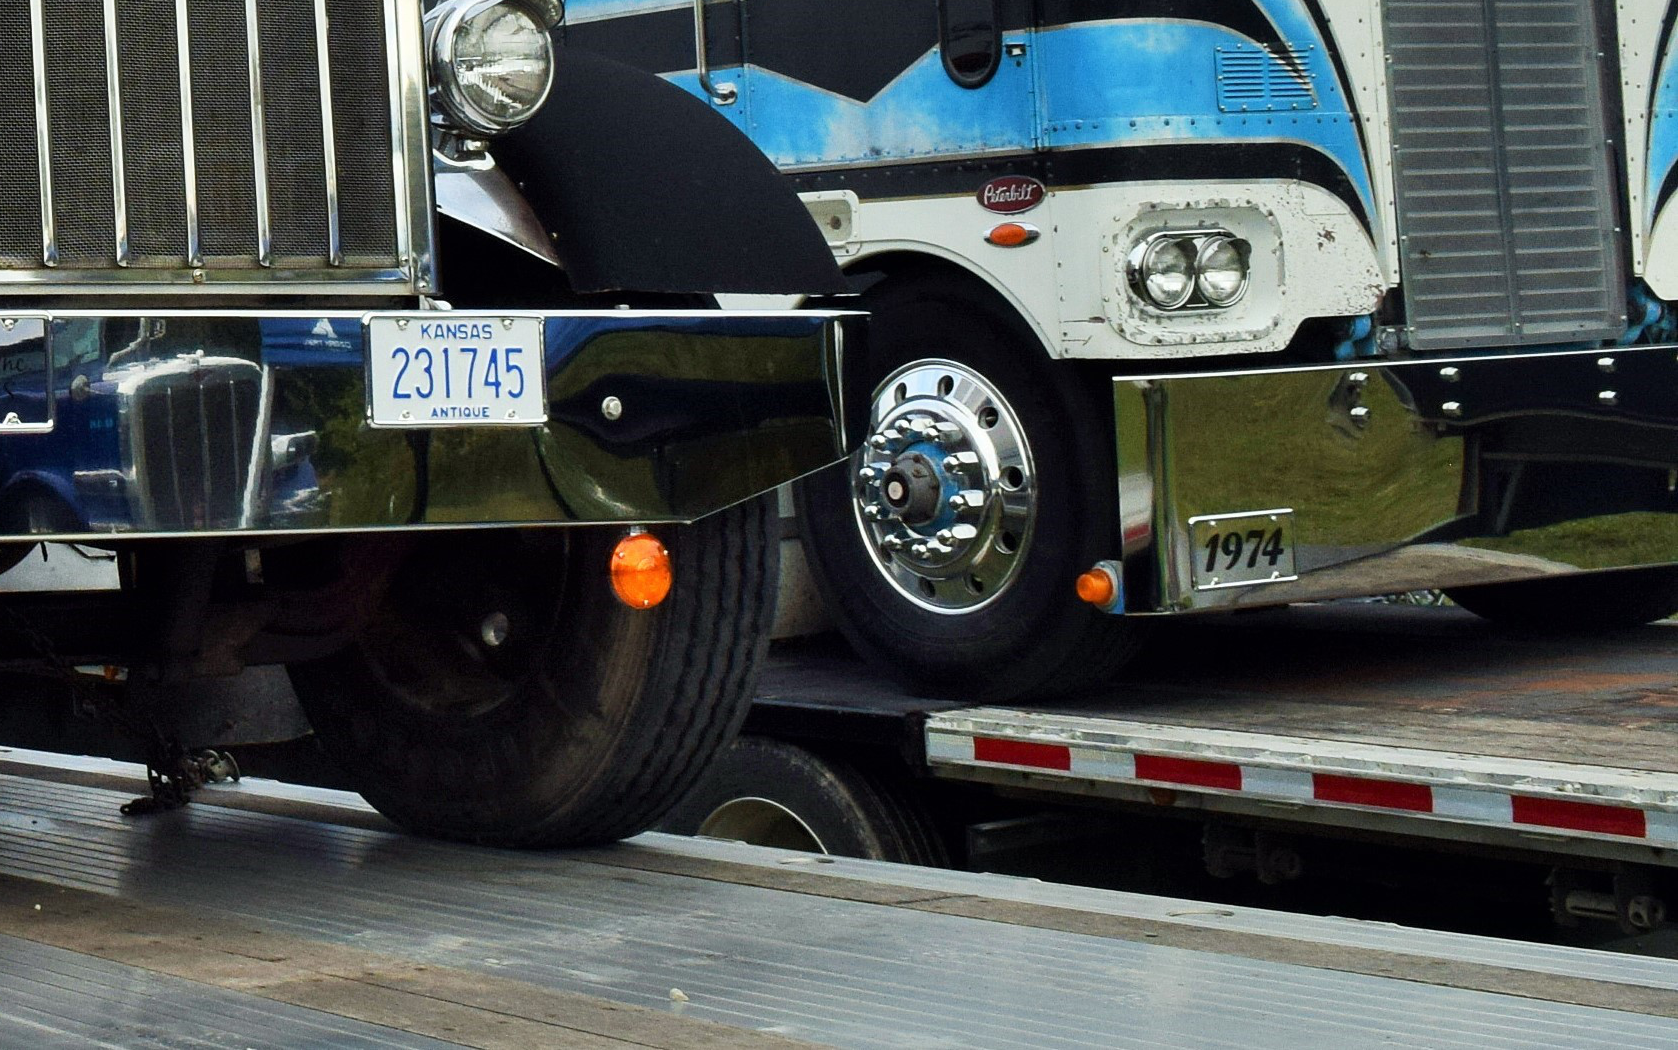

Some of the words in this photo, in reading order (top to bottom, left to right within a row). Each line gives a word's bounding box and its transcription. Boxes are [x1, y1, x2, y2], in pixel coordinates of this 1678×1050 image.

[984, 184, 1037, 205] Peterbilt
[420, 323, 492, 339] KANSAS
[391, 347, 524, 400] 231745
[430, 406, 490, 418] ANTIQUE
[1205, 526, 1284, 572] 1974
